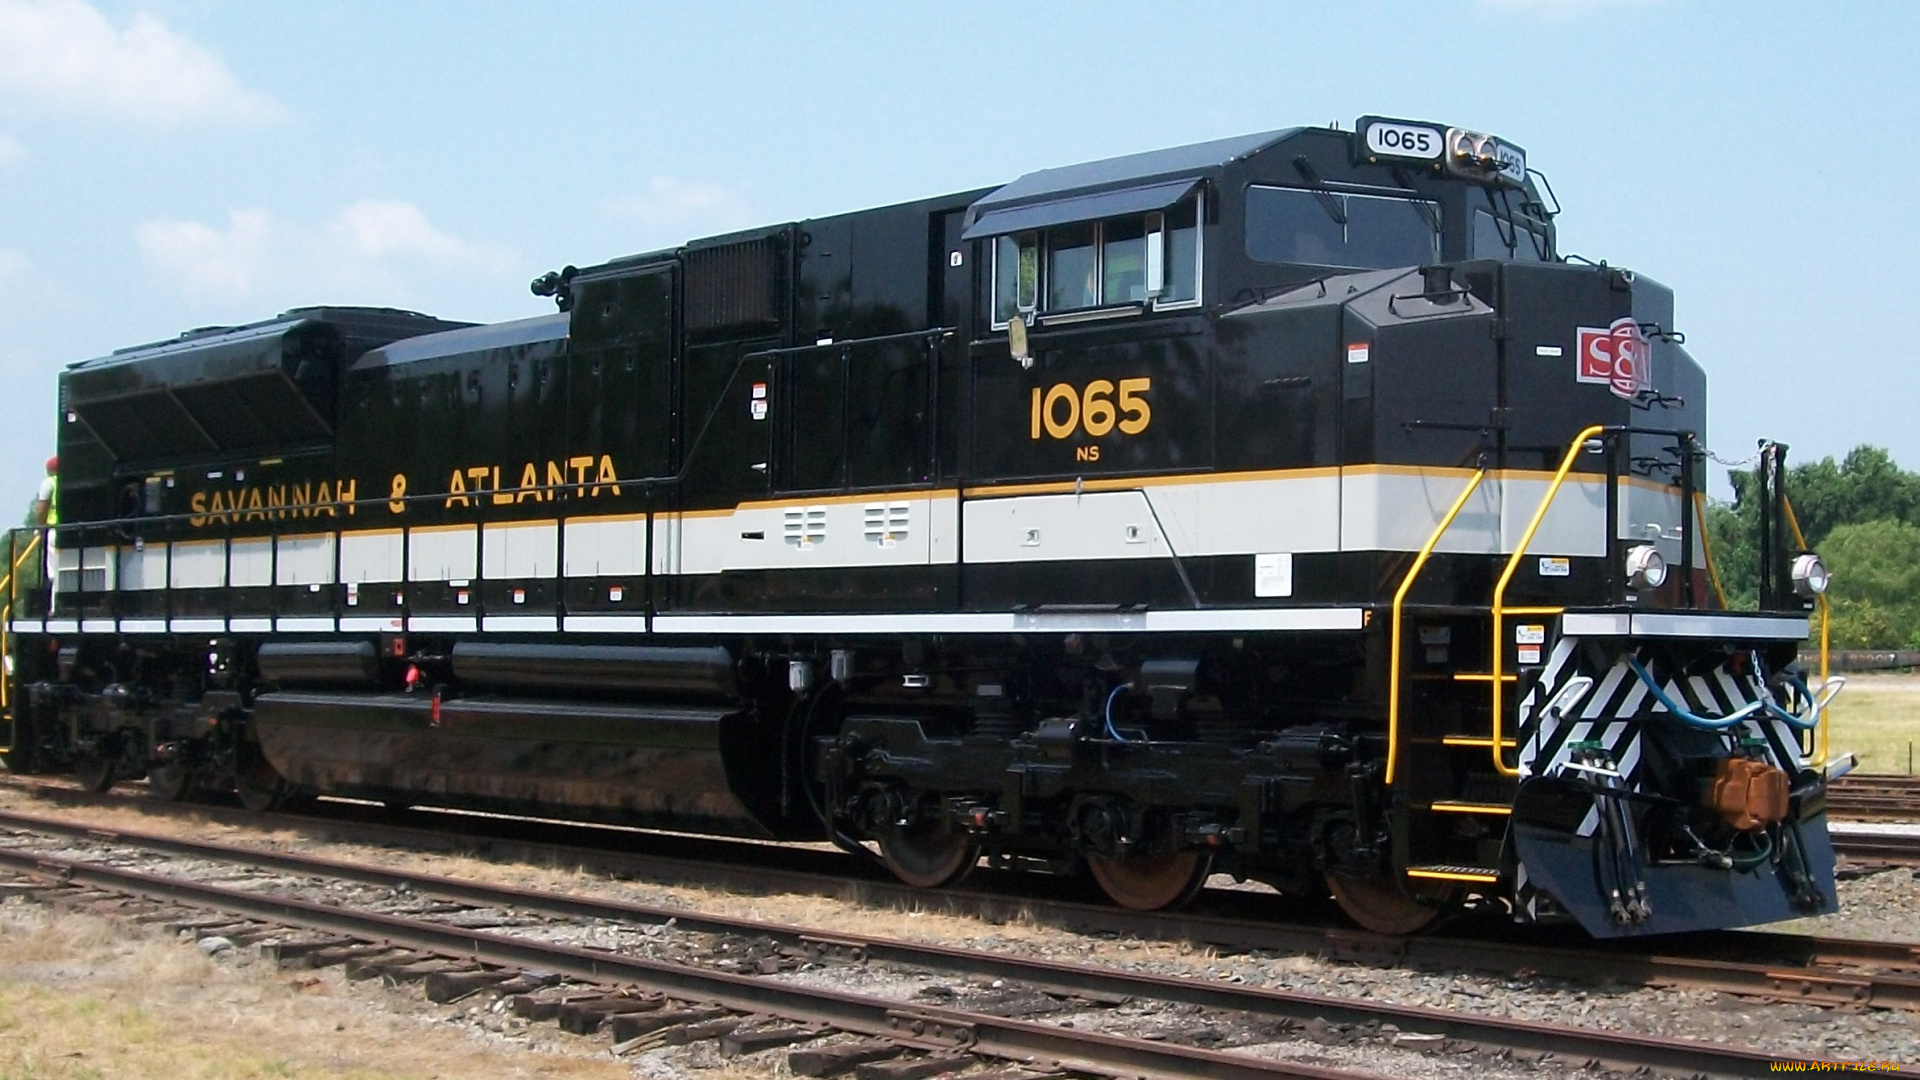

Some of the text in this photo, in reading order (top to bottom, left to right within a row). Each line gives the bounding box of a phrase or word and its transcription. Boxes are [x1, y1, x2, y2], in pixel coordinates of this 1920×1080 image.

[1378, 128, 1431, 152] 1065
[1031, 377, 1151, 439] 1065
[1076, 445, 1100, 461] NS
[189, 454, 621, 527] SAVANNAH & ATLANTA
[1364, 610, 1372, 626] F
